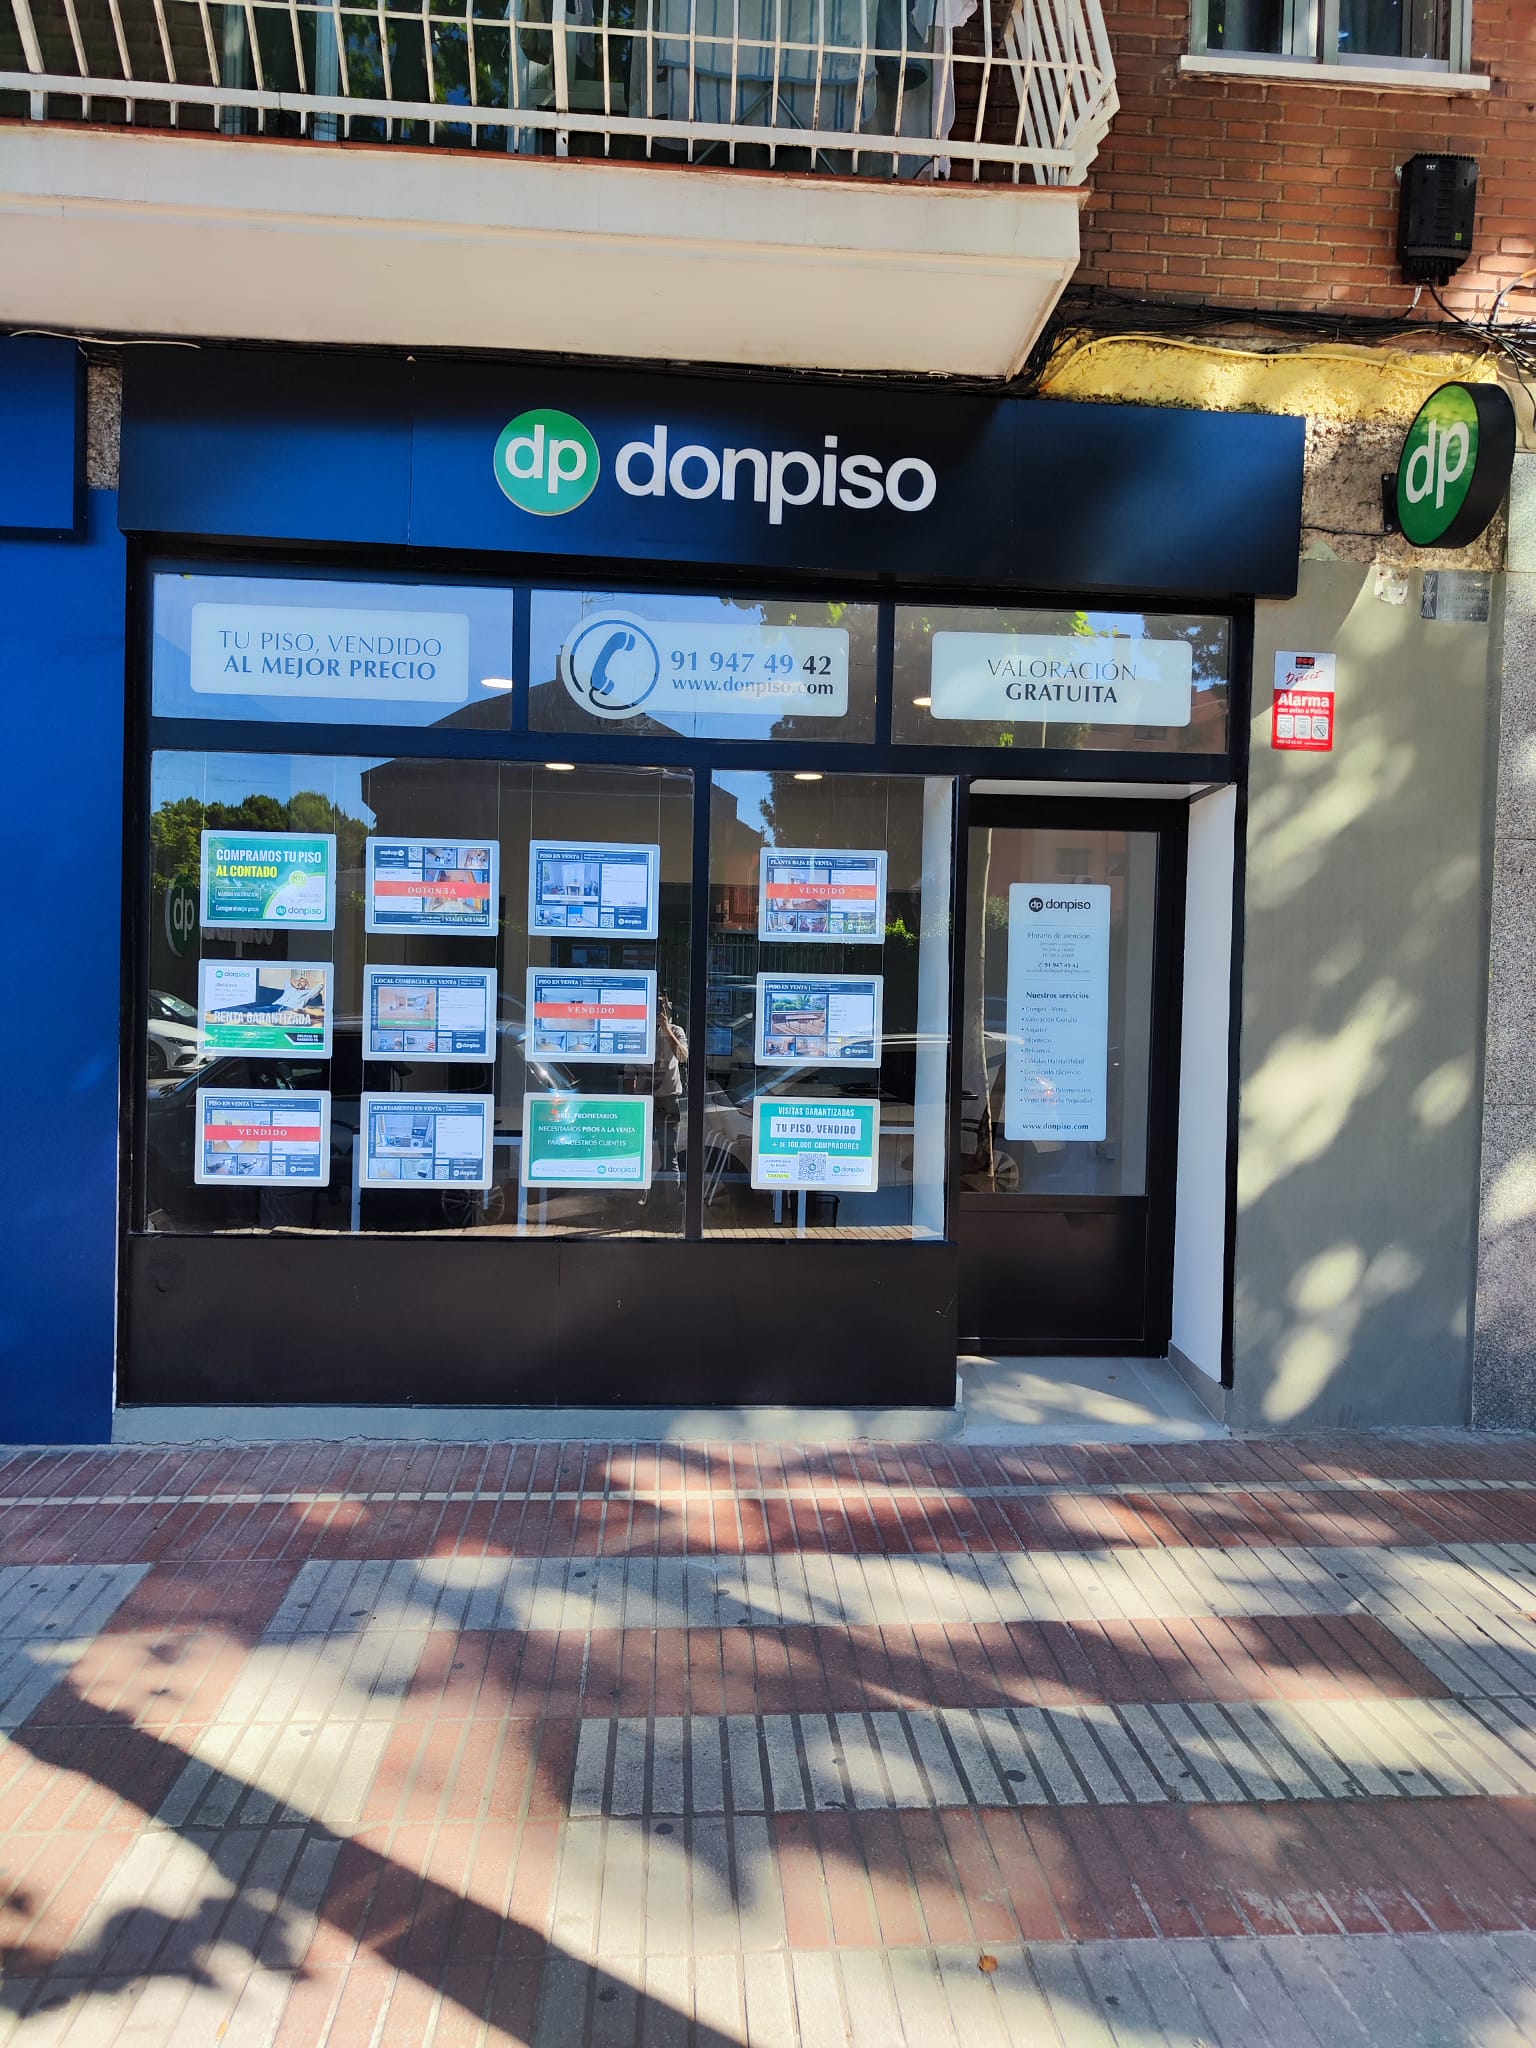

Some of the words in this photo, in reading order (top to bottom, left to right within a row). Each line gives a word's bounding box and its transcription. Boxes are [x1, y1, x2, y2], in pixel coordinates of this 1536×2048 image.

[1405, 418, 1469, 510] dp
[505, 424, 587, 494] dp
[615, 425, 937, 525] donpiso
[219, 630, 250, 649] TU
[262, 632, 320, 654] PISO,
[328, 635, 442, 657] VENDIDO
[223, 655, 252, 673] AL
[262, 656, 340, 679] MEJOR
[350, 659, 436, 680] PRECIO
[671, 650, 697, 671] 91
[709, 651, 755, 673] 947
[764, 654, 794, 674] 49
[802, 655, 832, 675] 42
[987, 659, 1137, 681] VALORACIÓN
[672, 676, 834, 698] www.donpiso.com
[1006, 682, 1118, 703] GRATUITA
[1278, 692, 1329, 707] Alarma
[216, 849, 282, 862] COMPRAMOS
[283, 850, 296, 862] TU
[298, 851, 322, 863] PISO
[216, 865, 228, 877] AL
[229, 865, 278, 878] CONTADO
[408, 886, 457, 895] VENDIDO
[799, 887, 846, 895] VENDIDO
[288, 905, 322, 917] donpiso
[1045, 899, 1091, 912] donpiso
[1026, 991, 1057, 999] Nuestros
[1058, 991, 1089, 1000] servicios
[568, 1006, 615, 1014] VENDIDO
[214, 1011, 244, 1023] RENTA
[246, 1011, 312, 1025] GARANTIZADA
[778, 1106, 803, 1115] VISITAS
[805, 1107, 855, 1117] GARANTIZADAS
[776, 1123, 787, 1133] TU
[790, 1123, 814, 1135] PISO,
[817, 1124, 856, 1135] VENDIDO
[1022, 1122, 1089, 1131] www.donpiso.com
[814, 1141, 860, 1150] COMPRADORES
[608, 1166, 637, 1174] donpiso
[841, 1166, 864, 1174] donpiso
